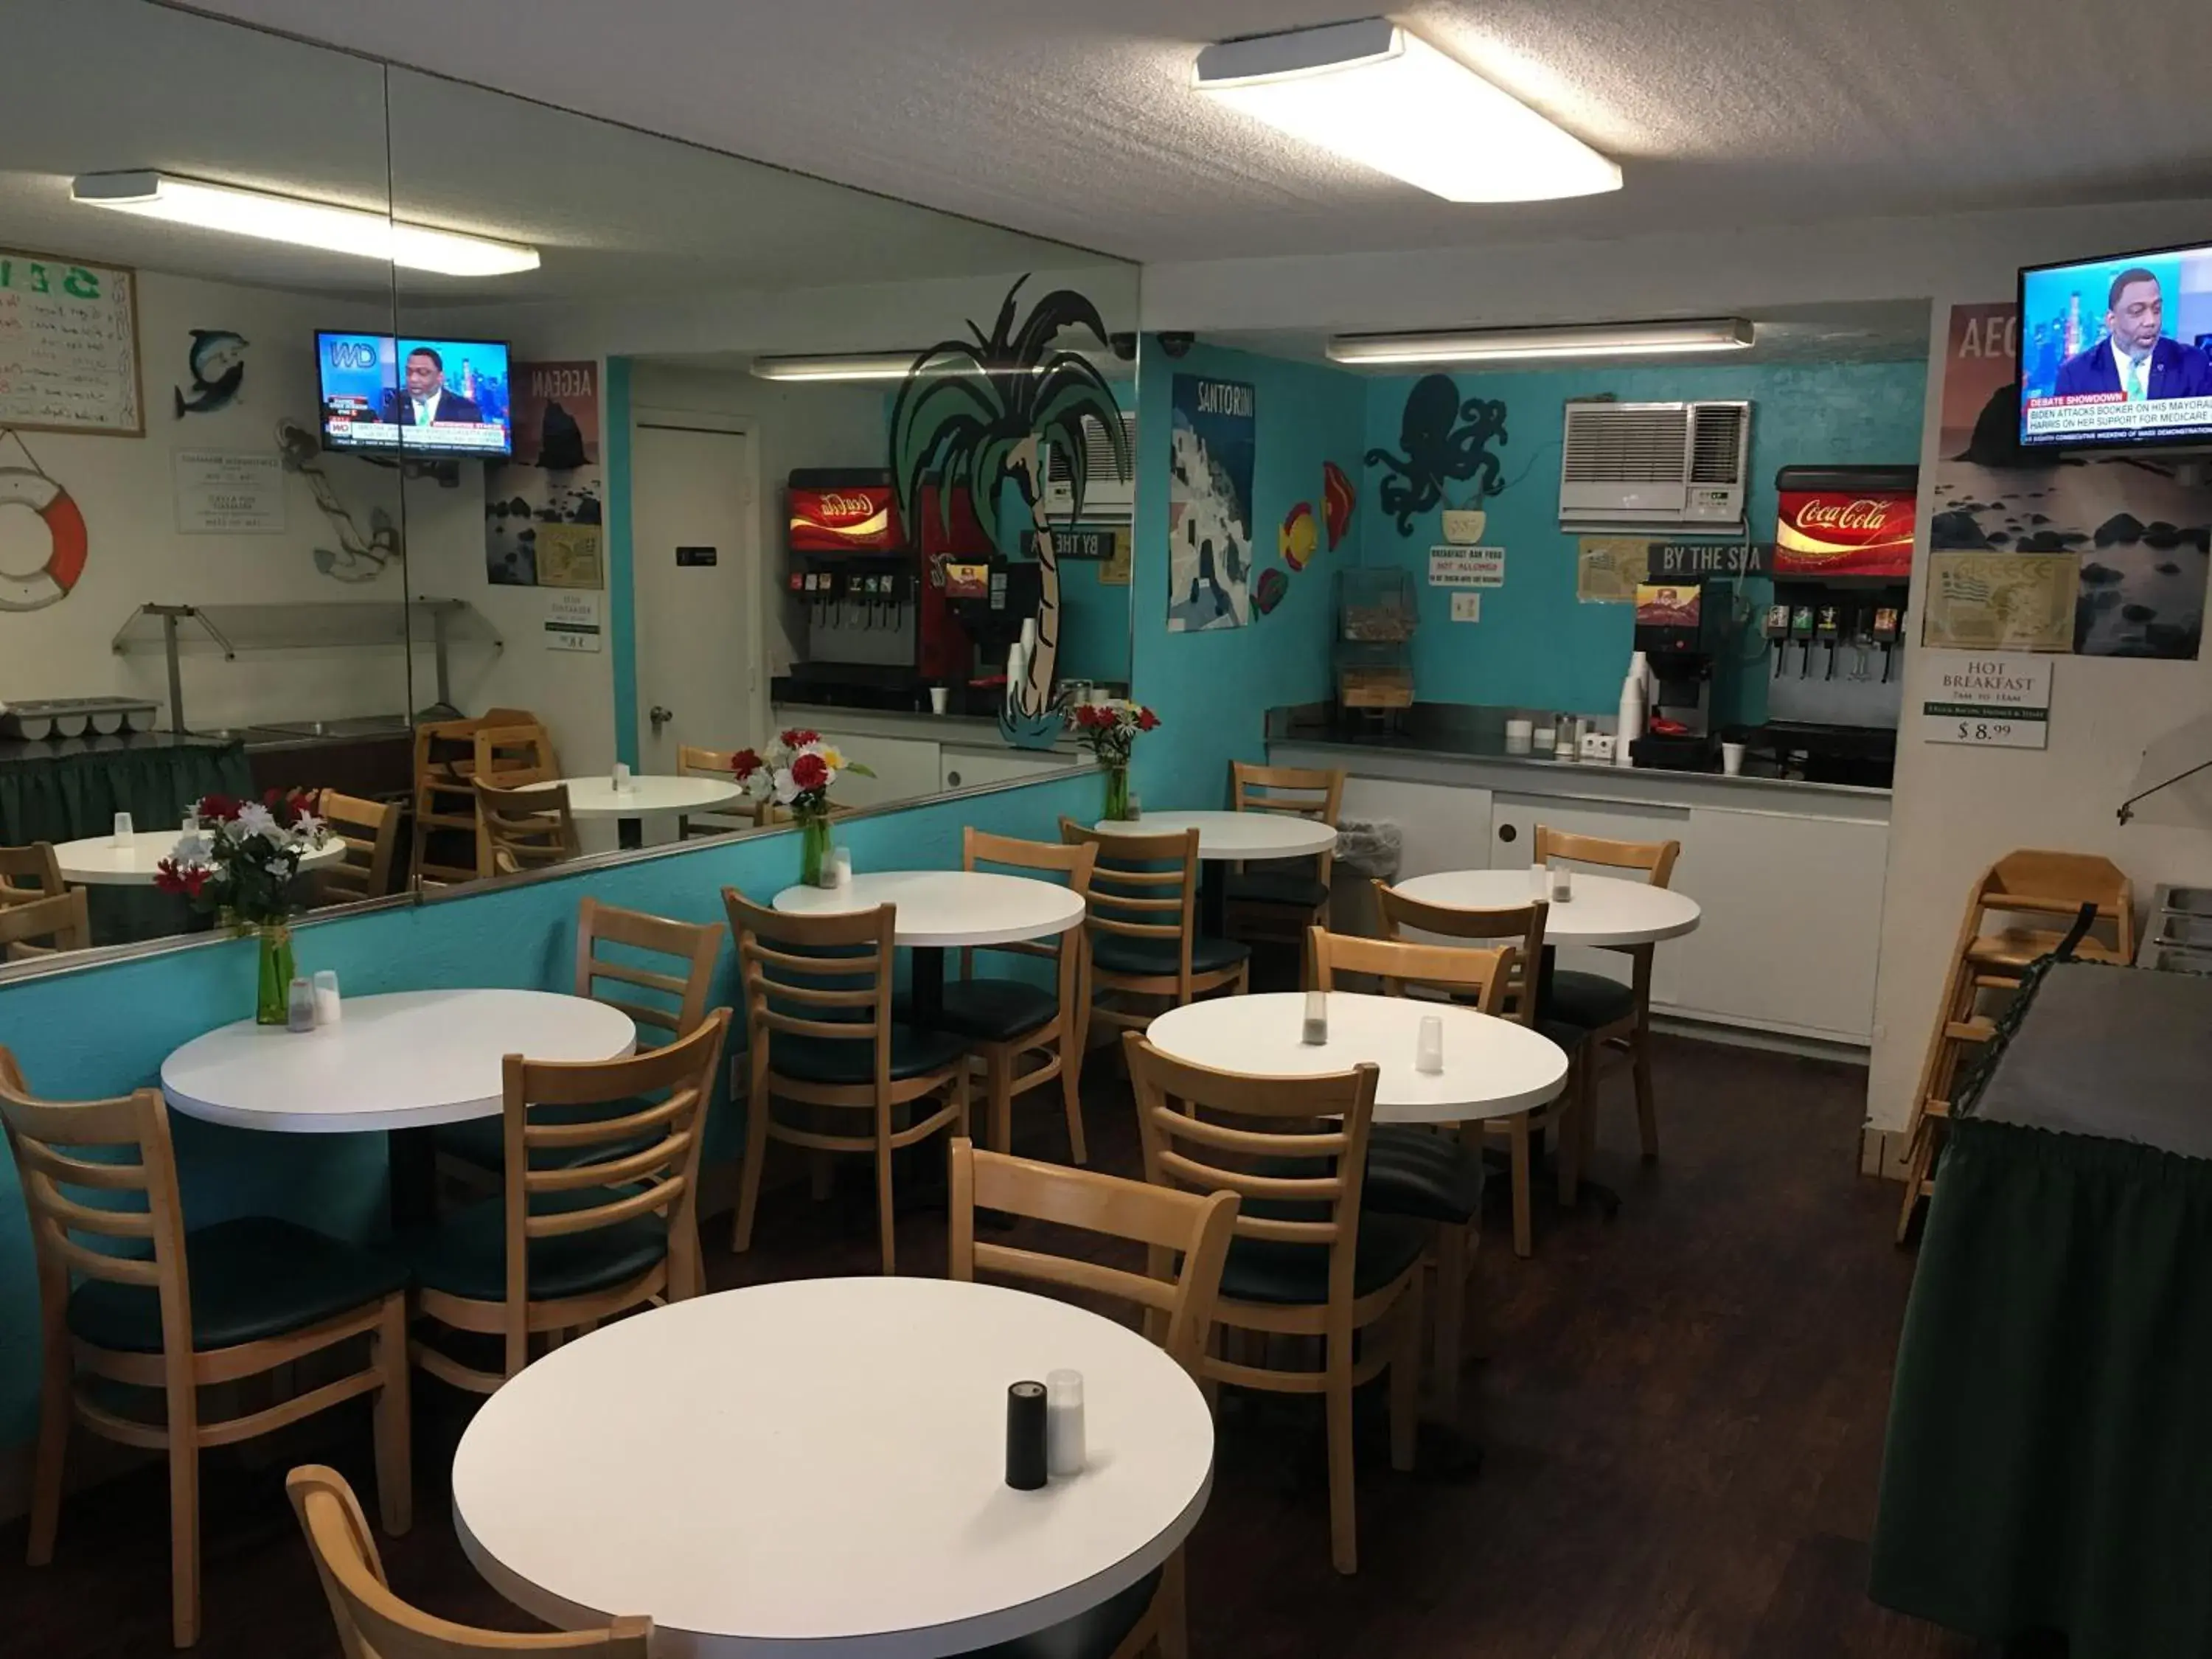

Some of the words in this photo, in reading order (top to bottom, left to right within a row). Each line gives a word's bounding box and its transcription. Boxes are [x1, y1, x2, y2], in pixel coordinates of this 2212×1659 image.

[1197, 381, 1253, 417] SANTORINI
[2031, 396, 2064, 407] DEBATE
[2066, 393, 2123, 405] SHOWDOWN
[2031, 409, 2055, 420] BIDEN
[2057, 406, 2095, 417] ATTACKS
[2097, 404, 2133, 415] BOOKER
[2136, 403, 2149, 412] ON
[2152, 402, 2166, 411] HIS
[2031, 420, 2060, 430] HARRIS
[2062, 419, 2075, 428] ON
[2077, 418, 2095, 427] HER
[2096, 415, 2137, 426] SUPPORT
[2140, 414, 2157, 424] FOR
[2160, 411, 2208, 422] MEDICARE
[1796, 499, 1893, 529] Coca-Cola
[1663, 546, 1684, 571] BY
[1689, 547, 1722, 569] THE
[1968, 661, 2006, 675] HOT
[1943, 674, 2036, 691] BREAKFAST
